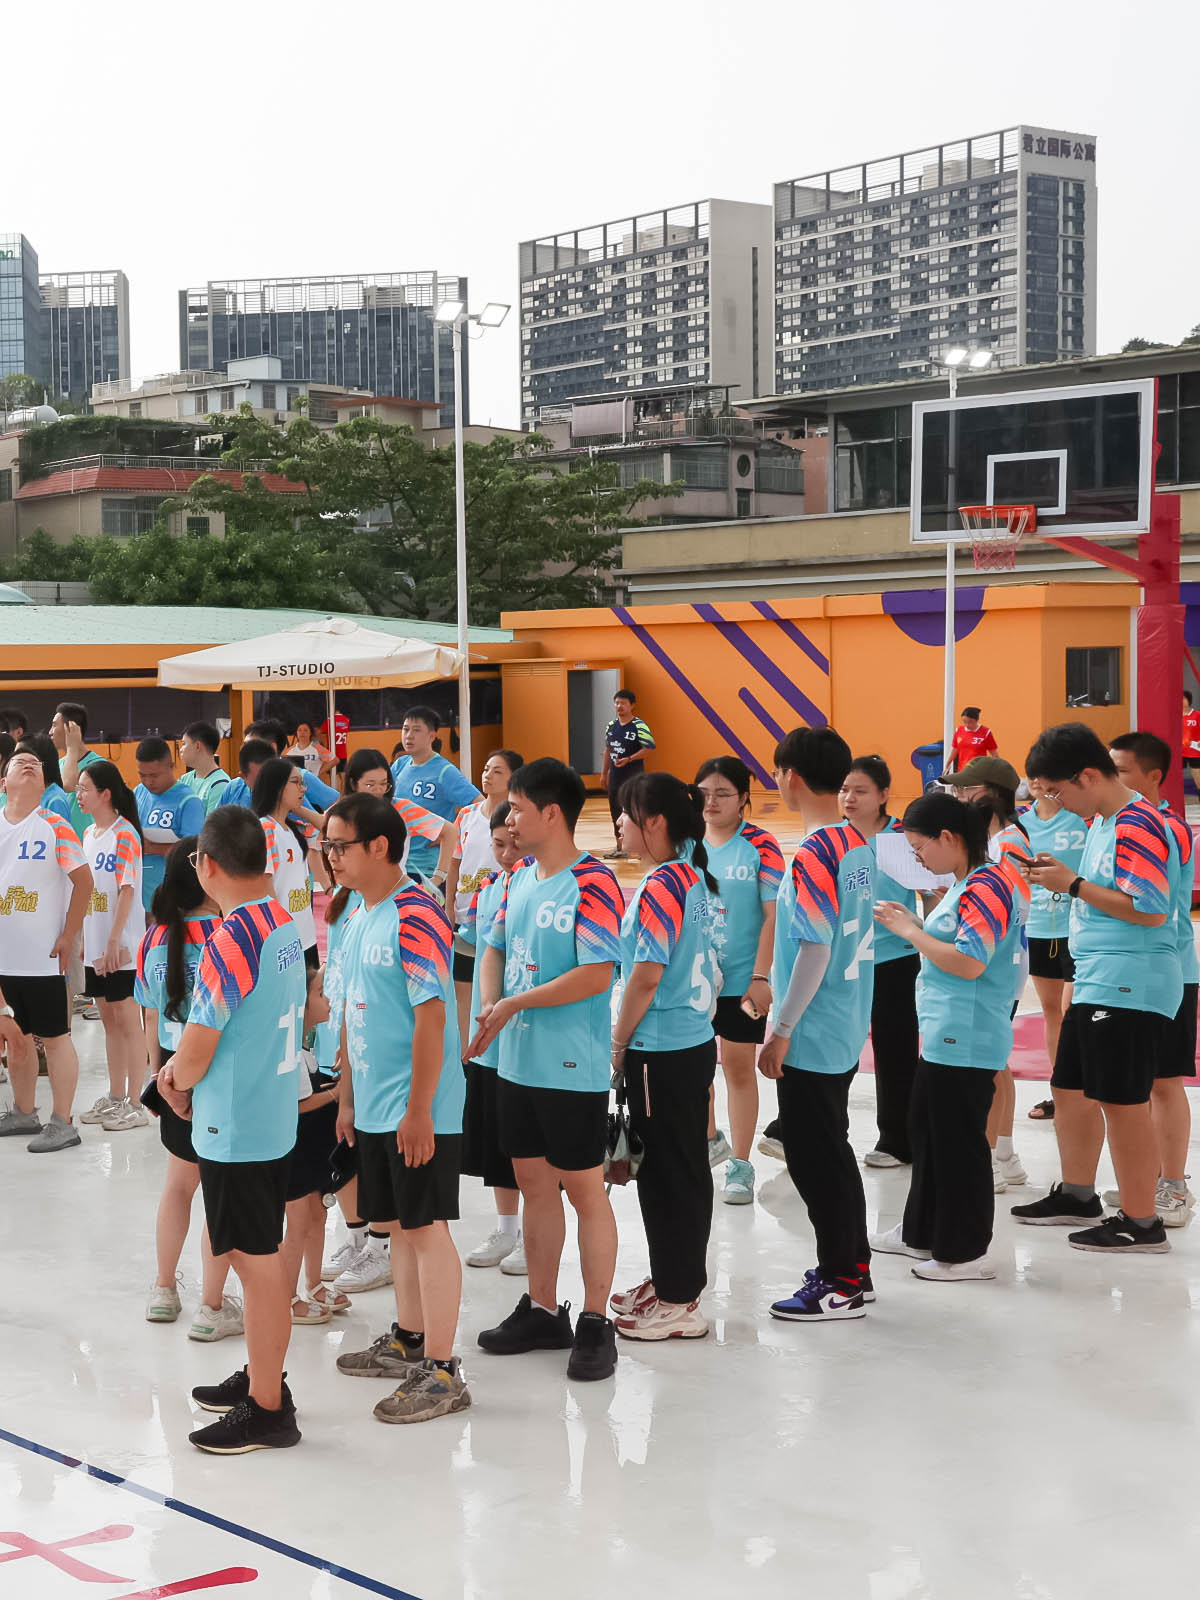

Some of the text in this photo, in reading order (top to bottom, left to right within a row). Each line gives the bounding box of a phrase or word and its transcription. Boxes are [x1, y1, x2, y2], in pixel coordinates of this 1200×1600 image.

[257, 662, 335, 678] TJ-STUDIO
[624, 731, 636, 741] 13
[971, 737, 984, 745] 37
[412, 781, 436, 800] 62
[148, 809, 174, 828] 68
[18, 840, 47, 860] 12
[1054, 830, 1086, 851] 52
[94, 852, 117, 873] 98
[536, 900, 574, 934] 66
